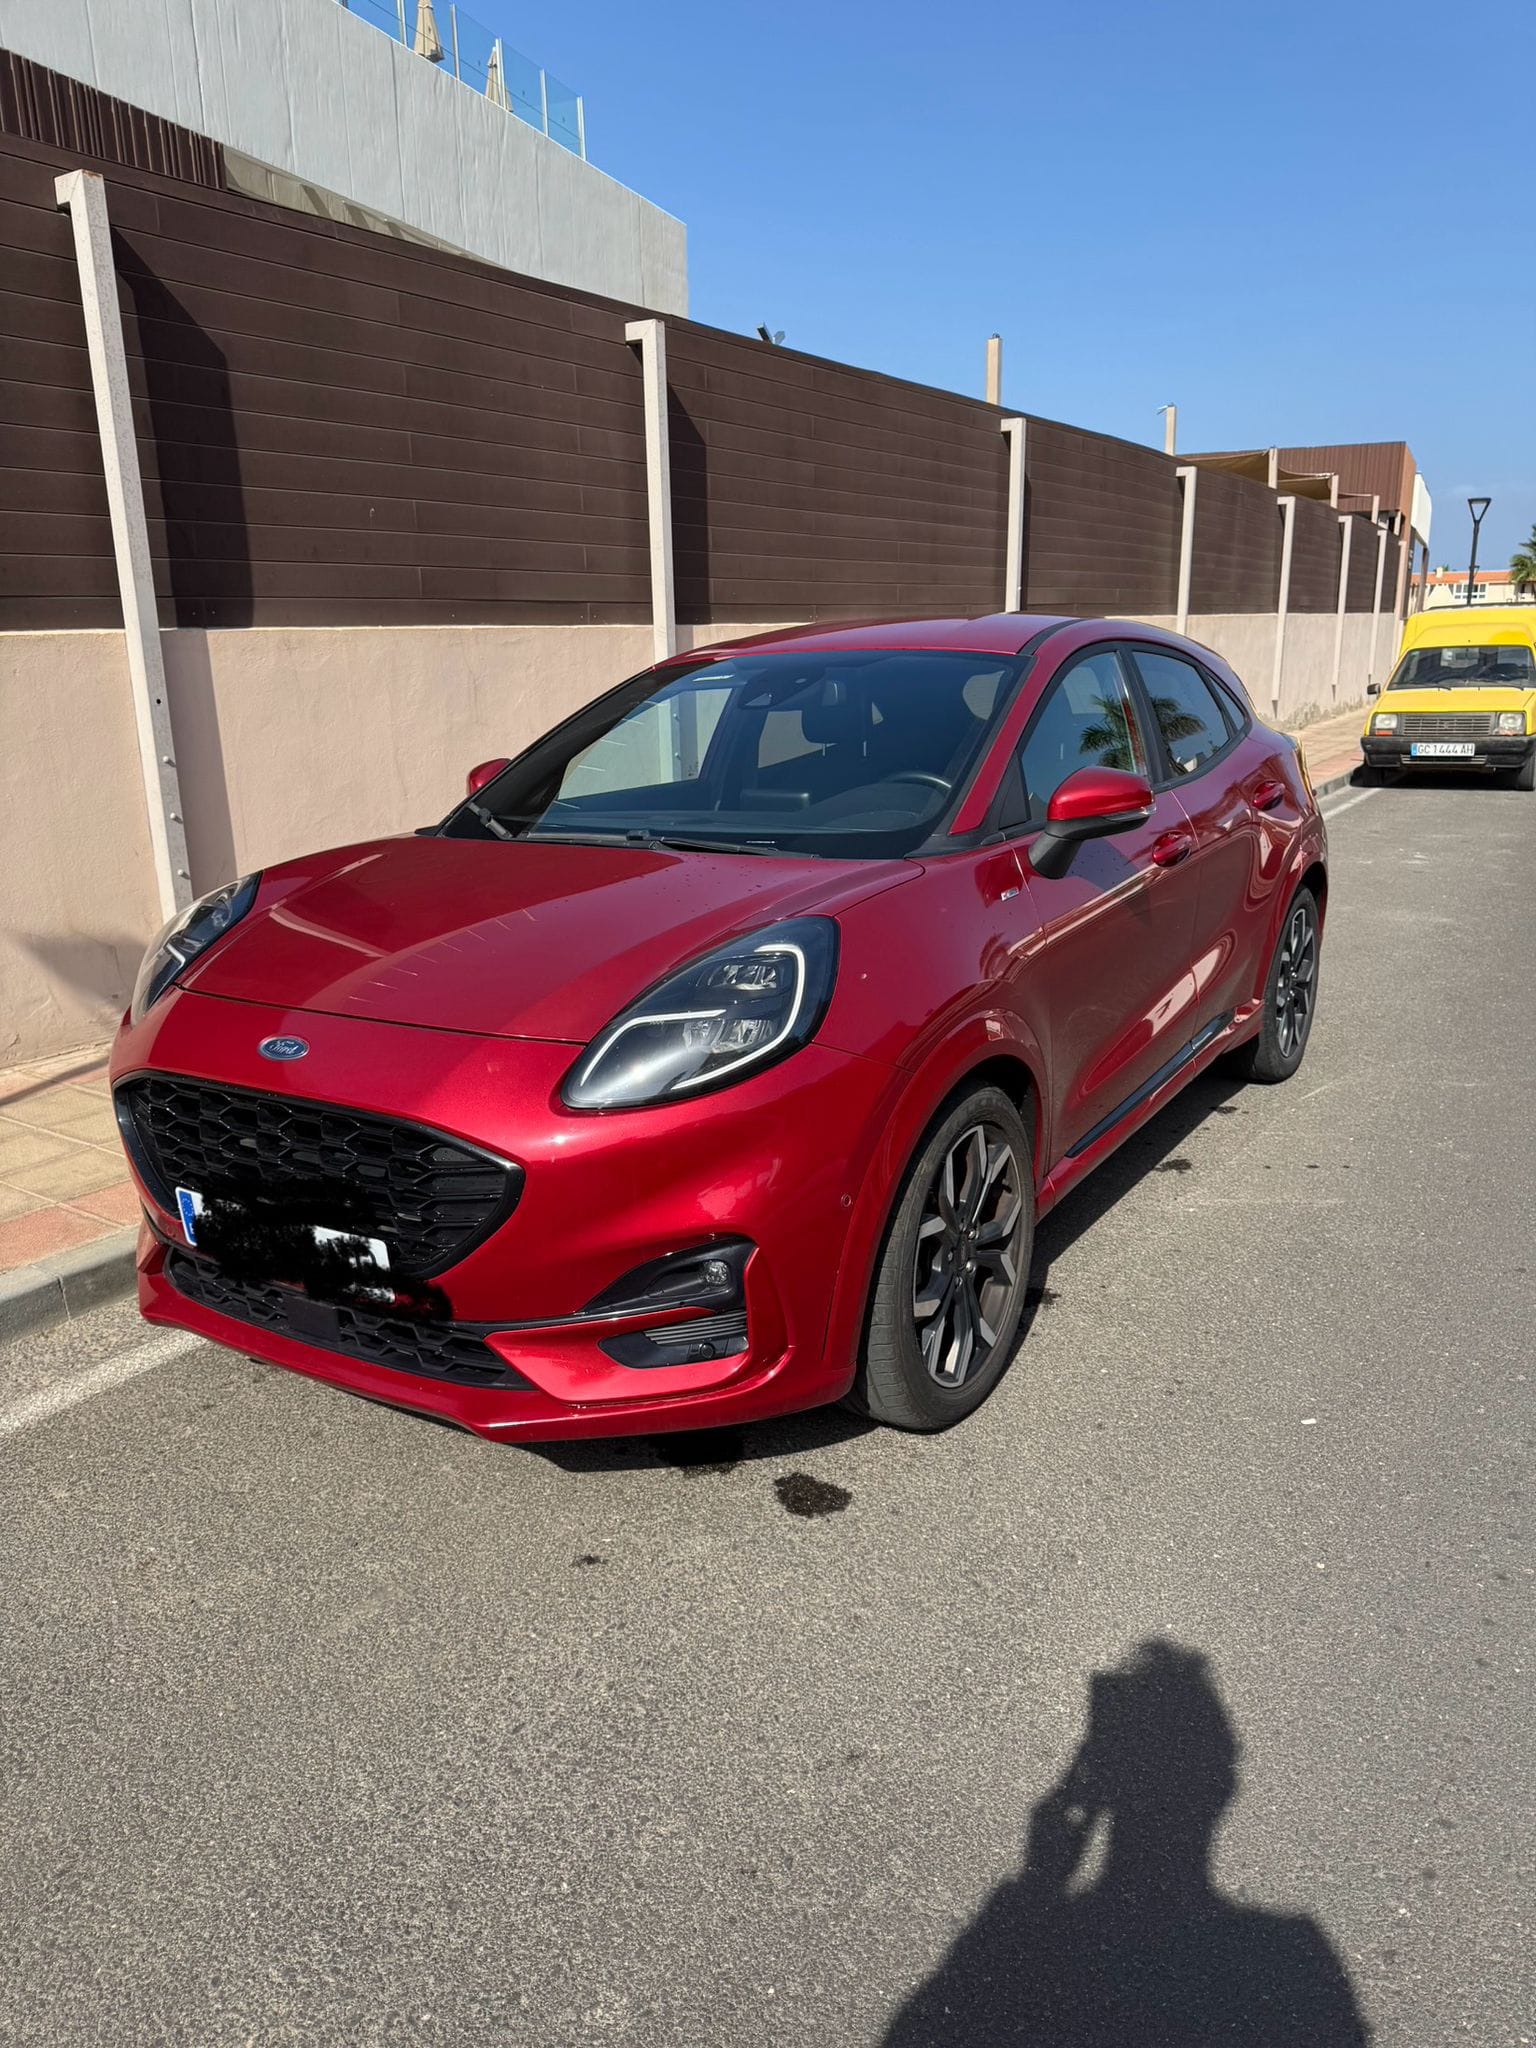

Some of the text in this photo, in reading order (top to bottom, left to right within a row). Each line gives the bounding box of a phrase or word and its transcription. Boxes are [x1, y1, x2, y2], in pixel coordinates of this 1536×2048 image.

[1418, 744, 1474, 754] GC 1444 AH
[269, 1040, 300, 1055] Ford
